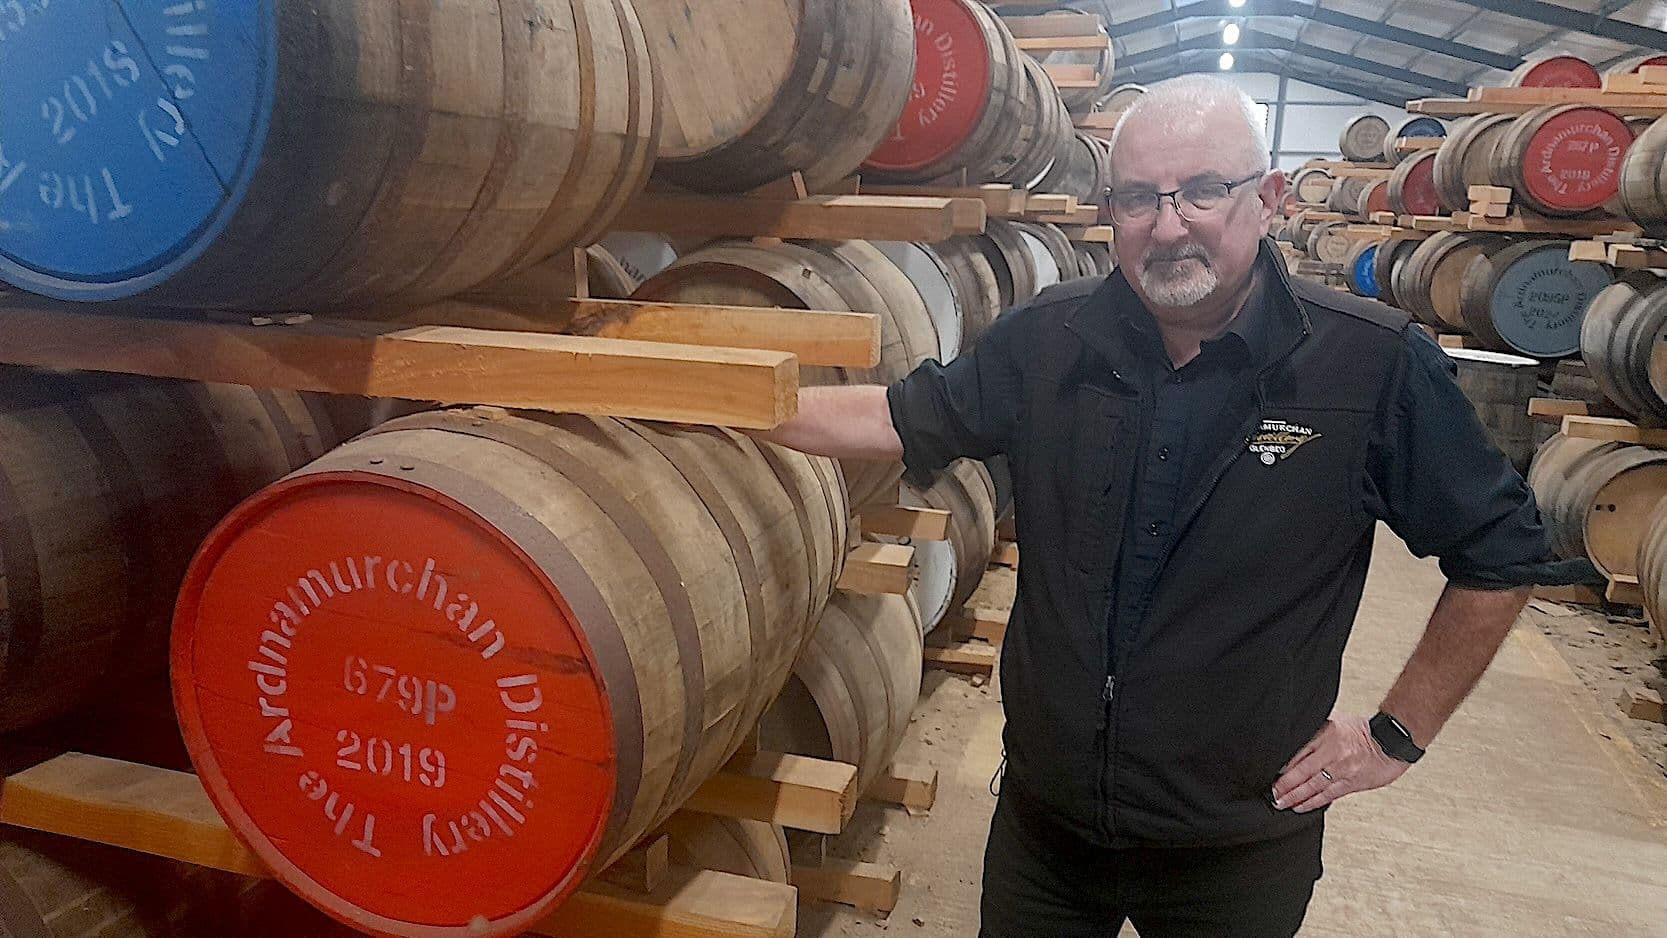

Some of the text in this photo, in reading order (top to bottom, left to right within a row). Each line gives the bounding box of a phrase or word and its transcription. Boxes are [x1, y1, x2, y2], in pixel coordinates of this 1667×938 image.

[919, 32, 958, 126] Distillery
[39, 168, 132, 224] The
[247, 555, 549, 859] The Ardnamurchan Distillery
[343, 655, 457, 725] 679P
[336, 729, 447, 788] 2019
